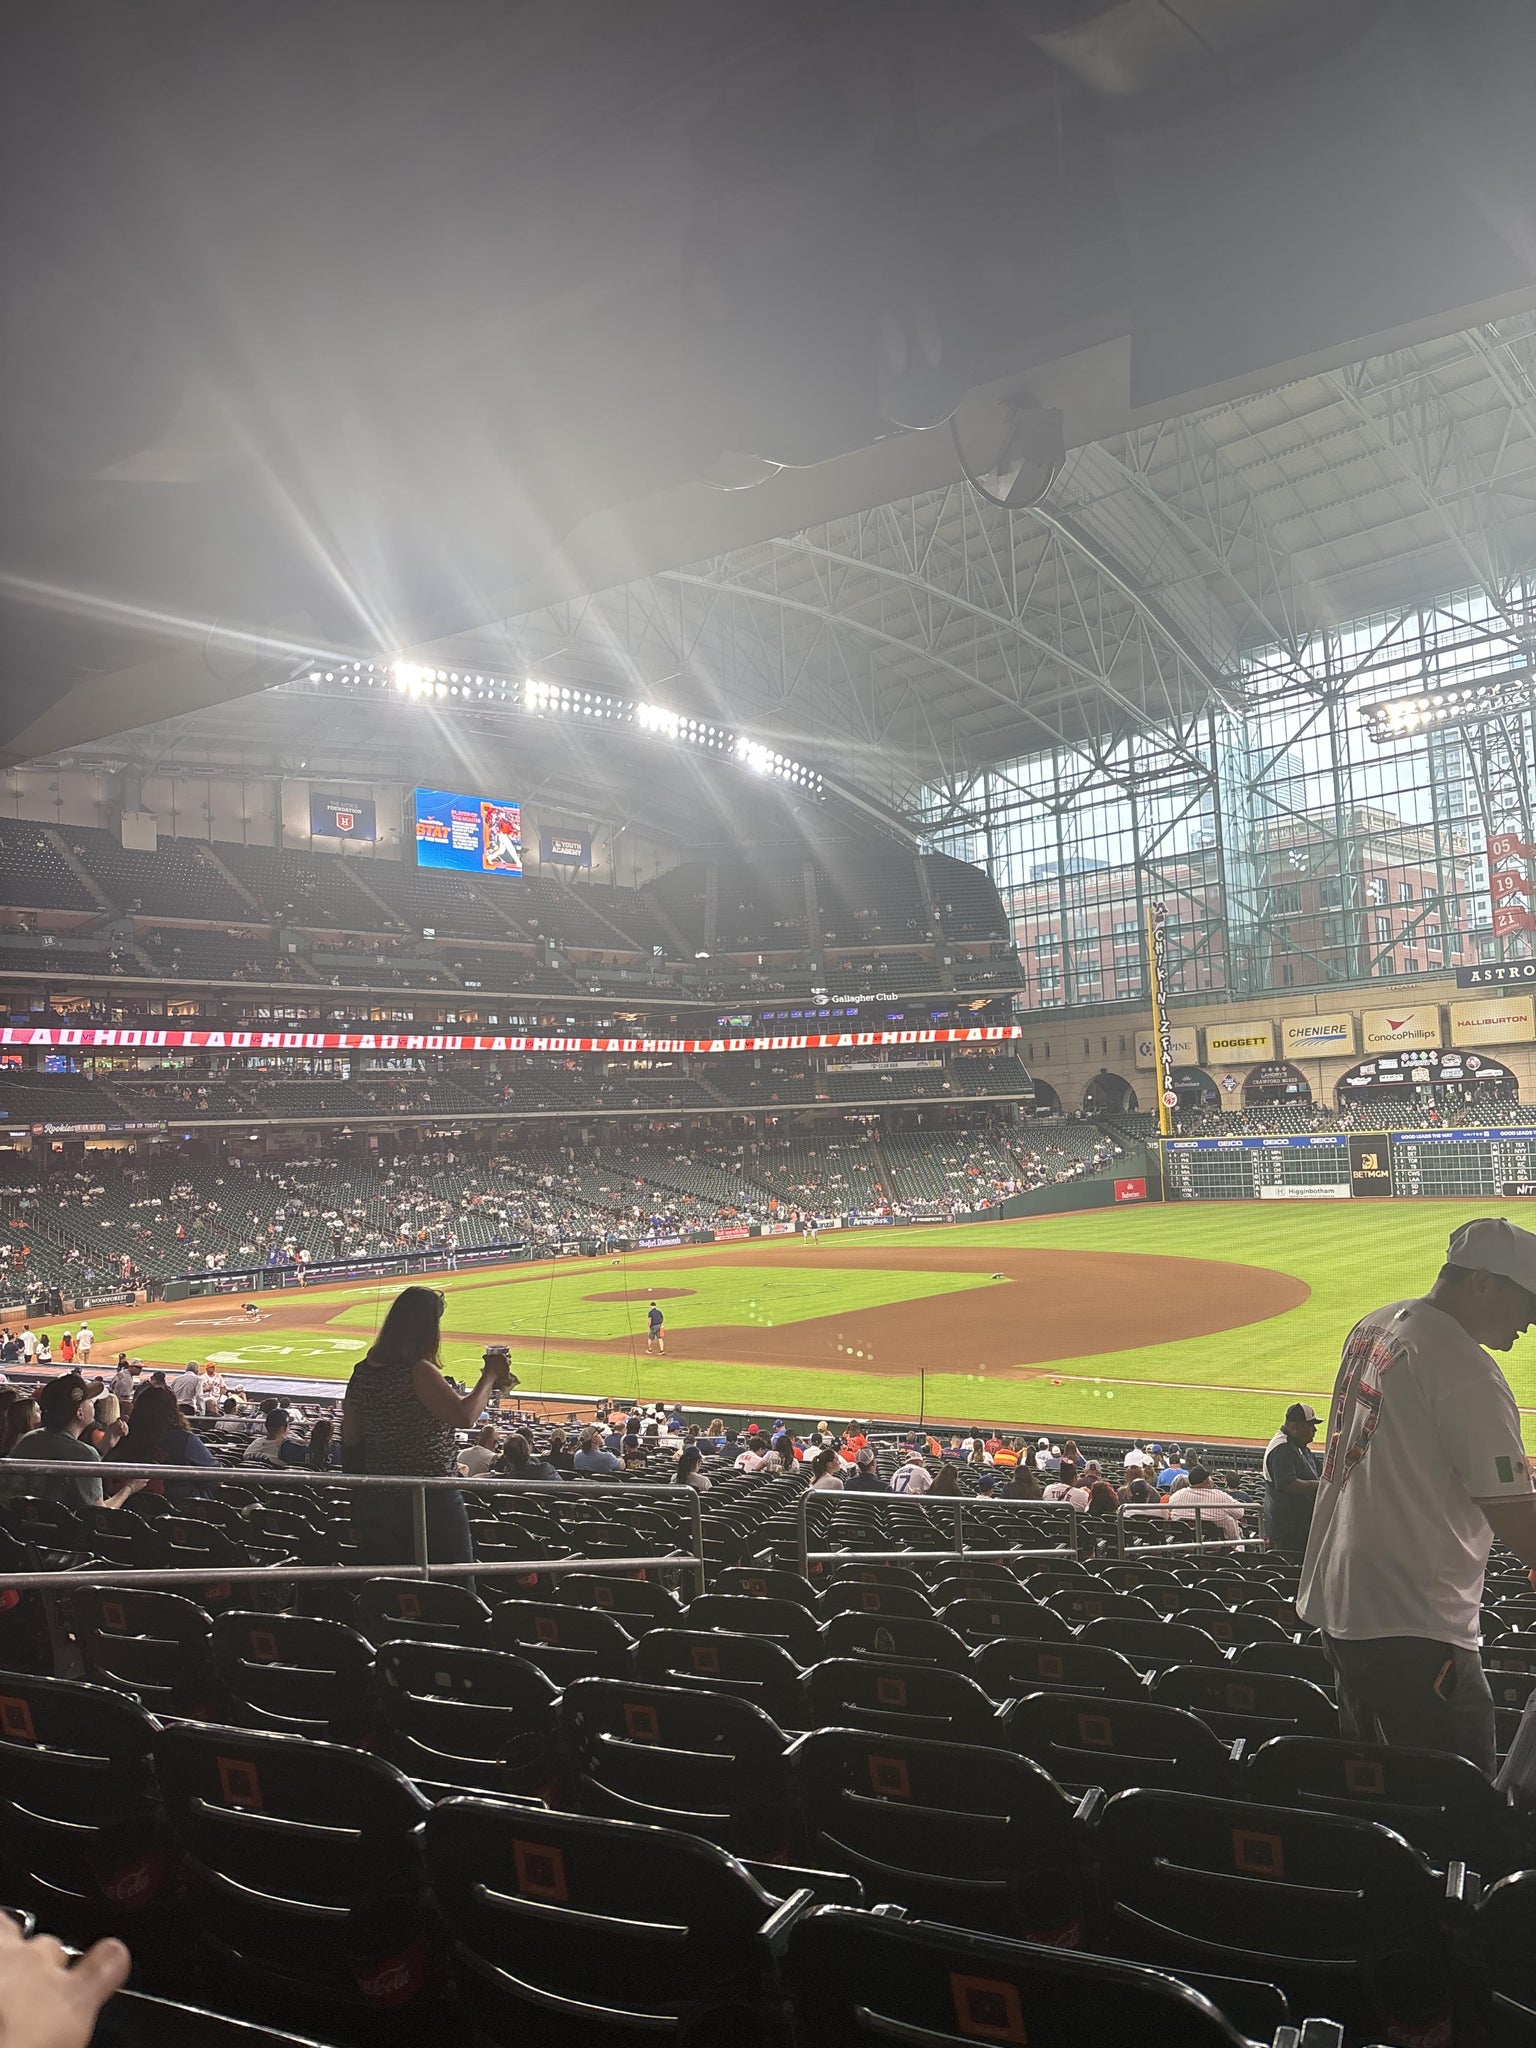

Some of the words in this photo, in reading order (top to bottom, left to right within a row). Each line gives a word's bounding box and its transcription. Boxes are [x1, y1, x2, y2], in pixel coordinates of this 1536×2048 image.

[416, 823, 451, 838] STAT
[562, 841, 582, 850] YOUTH
[1492, 838, 1511, 856] 05
[1496, 876, 1514, 893] 19
[1498, 911, 1515, 927] 21
[1154, 930, 1168, 1005] CHIKIN
[1471, 965, 1536, 982] ASTRO
[832, 993, 875, 1004] Gallagher
[876, 992, 899, 1001] Club
[1457, 1015, 1528, 1027] HALLIBURTON
[1289, 1024, 1347, 1038] CHENIERE
[1368, 1030, 1435, 1042] ConocoPhillips
[94, 1029, 167, 1046] HOU
[261, 1032, 324, 1047] HOU
[407, 1035, 462, 1049] HOU
[533, 1037, 580, 1051] HOU
[643, 1038, 685, 1052] HOU
[754, 1035, 807, 1050] HOU
[882, 1030, 936, 1044] HOU
[1213, 1037, 1267, 1048] DOGGETT
[1160, 1037, 1173, 1090] FAIR
[44, 1123, 75, 1134] Rookies
[1353, 1170, 1389, 1178] BETMGM
[1288, 1188, 1334, 1196] Higginbotham
